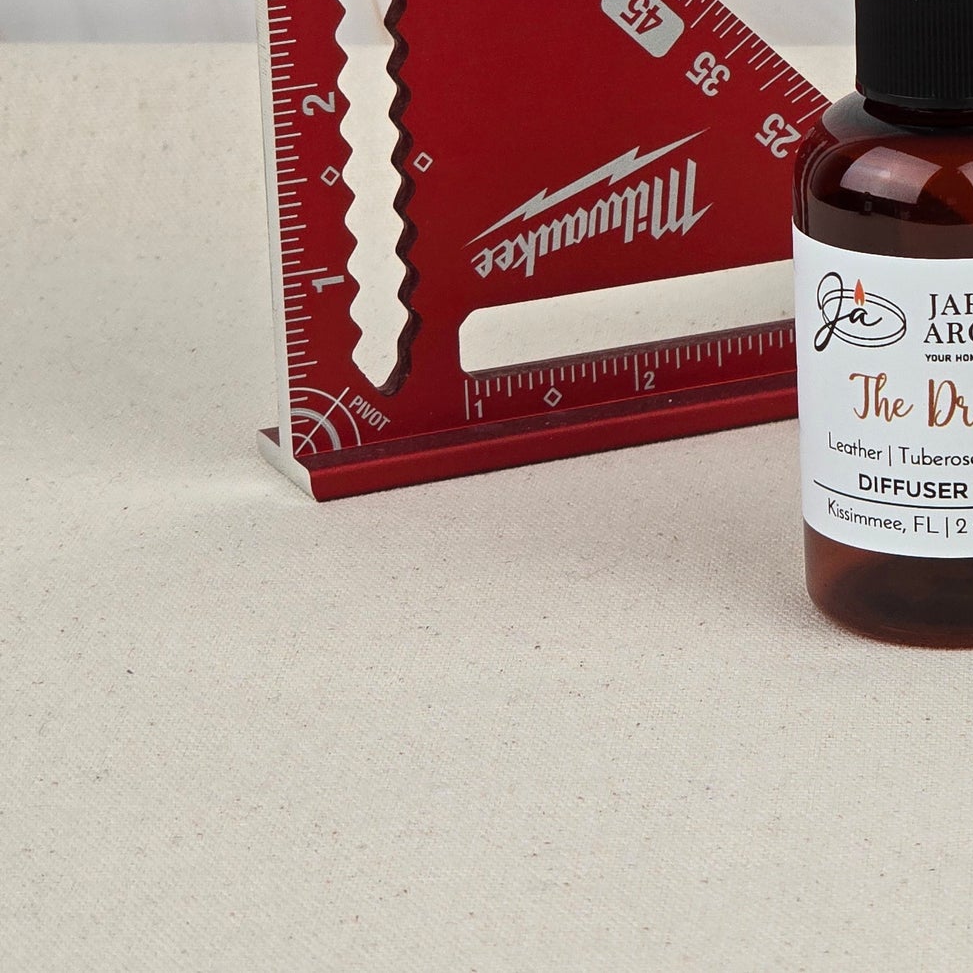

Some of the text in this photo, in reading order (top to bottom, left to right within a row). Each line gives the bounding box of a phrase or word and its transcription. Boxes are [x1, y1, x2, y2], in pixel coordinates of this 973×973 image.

[686, 52, 730, 96] 35
[302, 92, 335, 115] 2
[755, 114, 801, 158] 25
[473, 158, 713, 279] Milwaukee
[312, 275, 344, 292] 1
[925, 354, 951, 362] YOUR
[475, 372, 654, 417] 1 2
[849, 372, 914, 423] The
[352, 396, 390, 430] PIVOT
[829, 432, 882, 460] Leather
[859, 473, 968, 499] DIFFUSER
[828, 498, 906, 533] Kissimmee,
[914, 516, 939, 533] FL
[956, 518, 967, 533] 2
